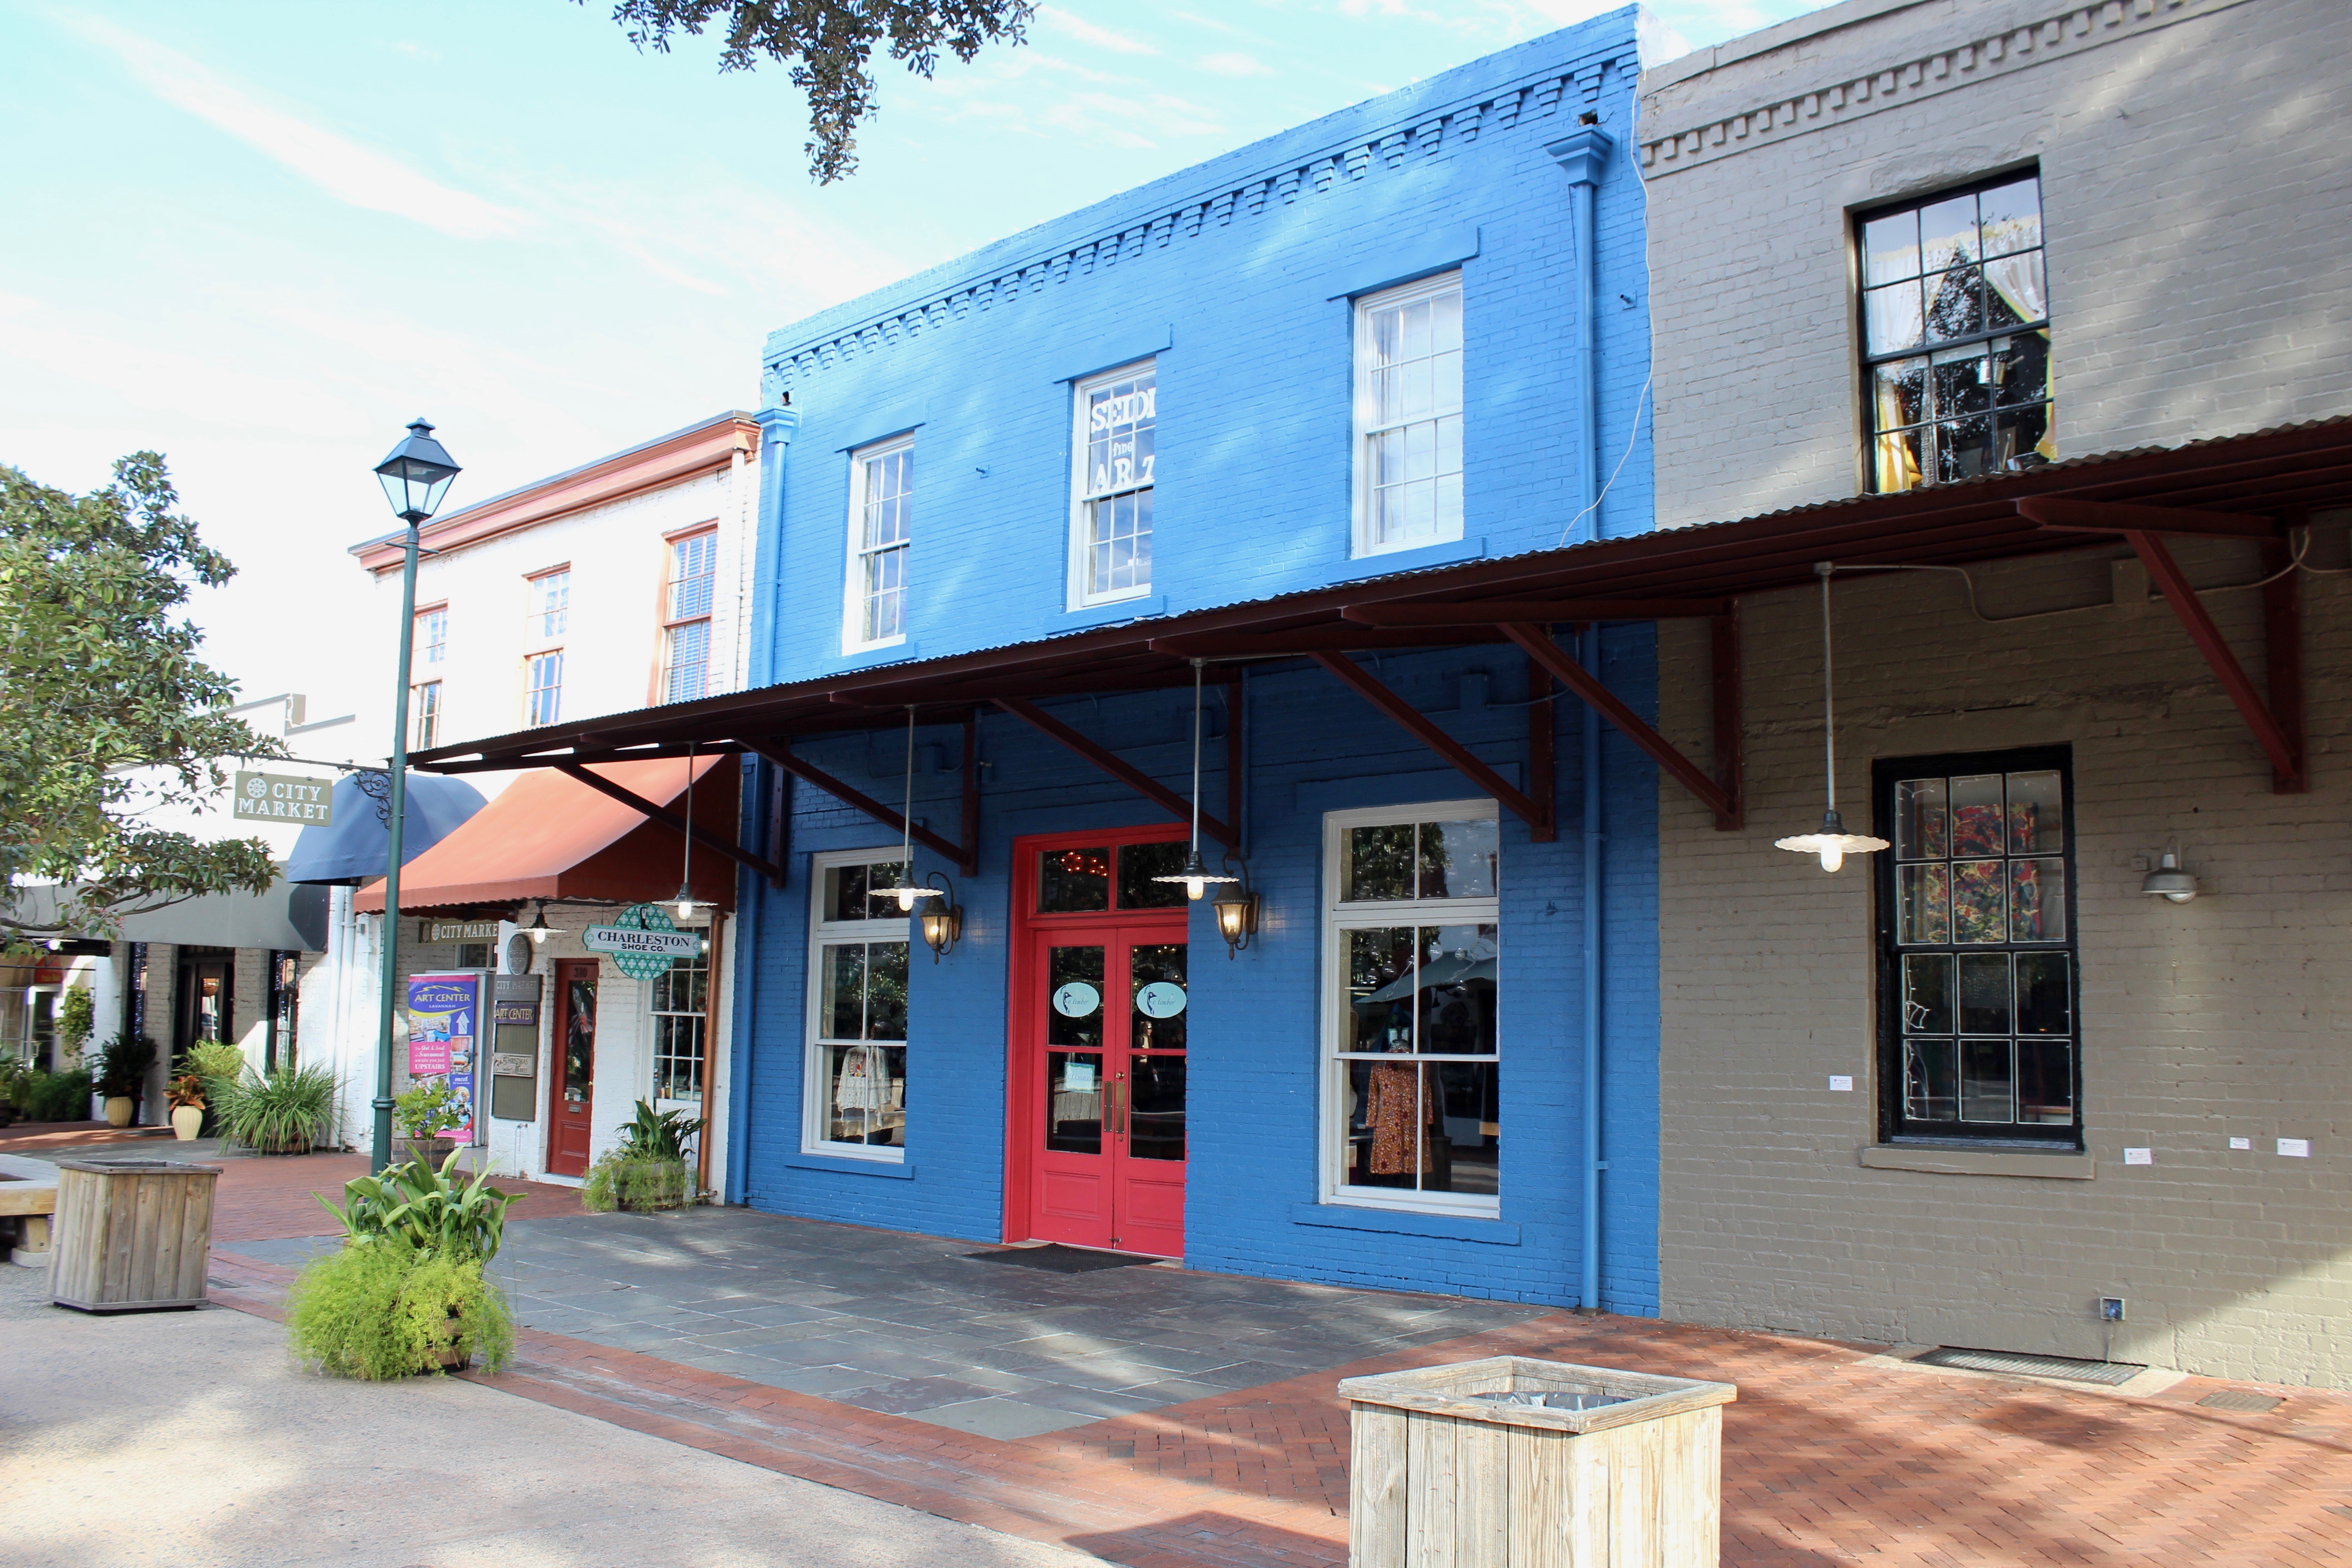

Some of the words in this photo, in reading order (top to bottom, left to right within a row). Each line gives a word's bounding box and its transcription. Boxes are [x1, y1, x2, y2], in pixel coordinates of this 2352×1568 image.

[1113, 441, 1133, 457] fine
[272, 783, 322, 801] CITY
[238, 798, 328, 819] MARKET
[441, 925, 462, 939] CITY
[464, 923, 498, 938] MARKE
[598, 931, 691, 947] CHARLESTON
[496, 981, 510, 989] CITY
[512, 980, 537, 990] MARKET
[414, 994, 435, 1002] ART
[436, 993, 470, 1002] CENTER
[495, 1008, 509, 1019] ART
[509, 1008, 533, 1020] CENTER
[1067, 1074, 1092, 1082] CLOSED
